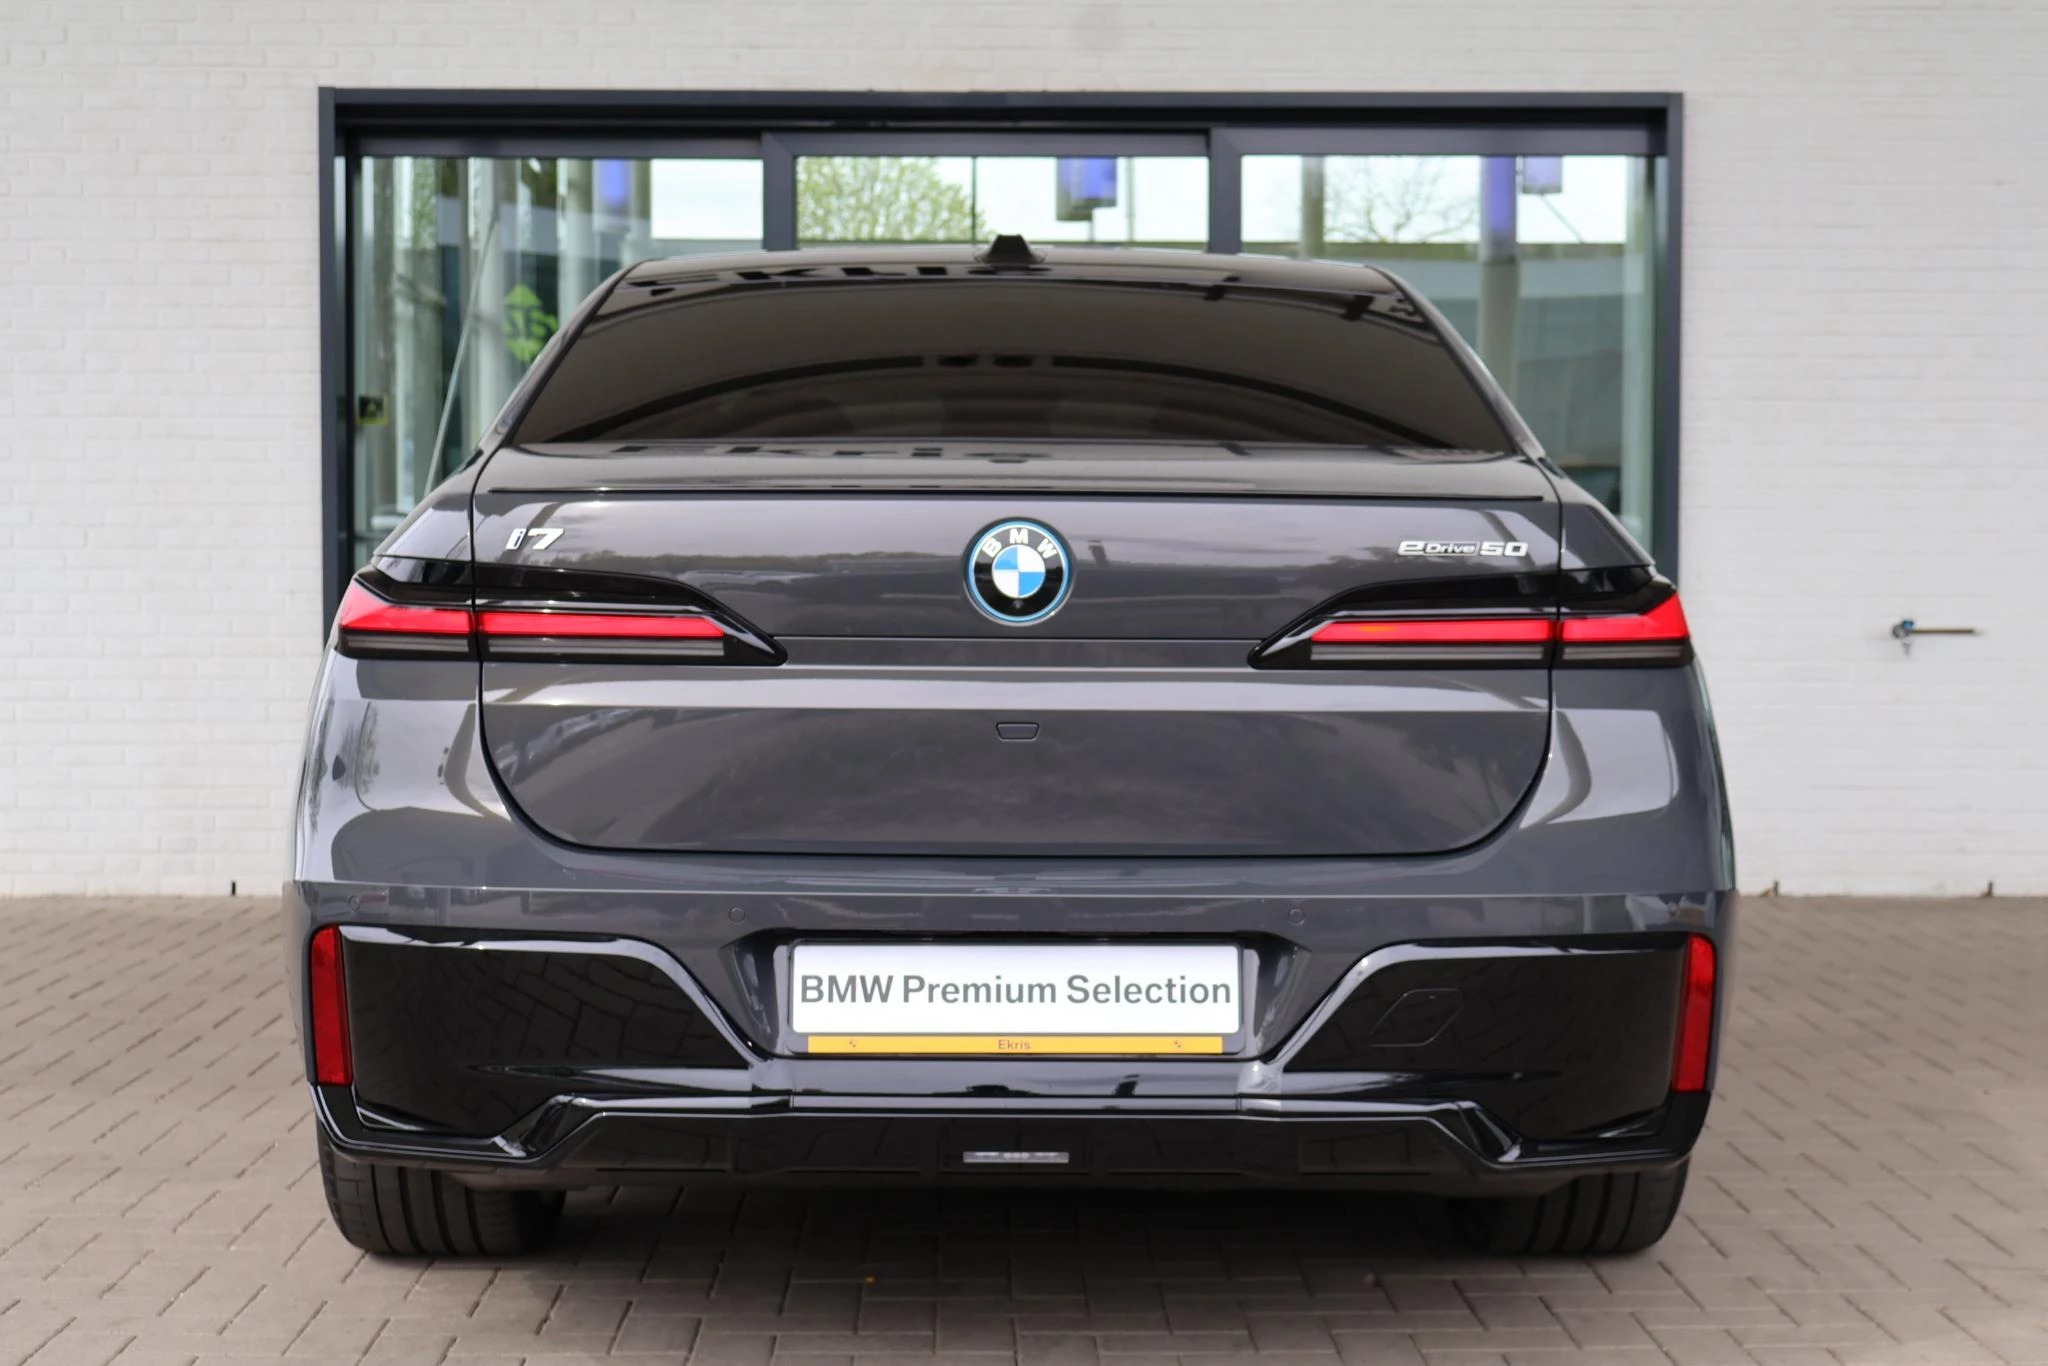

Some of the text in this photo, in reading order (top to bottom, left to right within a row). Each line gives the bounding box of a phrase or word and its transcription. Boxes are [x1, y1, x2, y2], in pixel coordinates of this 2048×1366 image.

[505, 527, 565, 551] i7
[981, 528, 1058, 559] BMW
[800, 974, 1231, 1004] BMW Premium Selection
[998, 1039, 1031, 1050] Ekris
